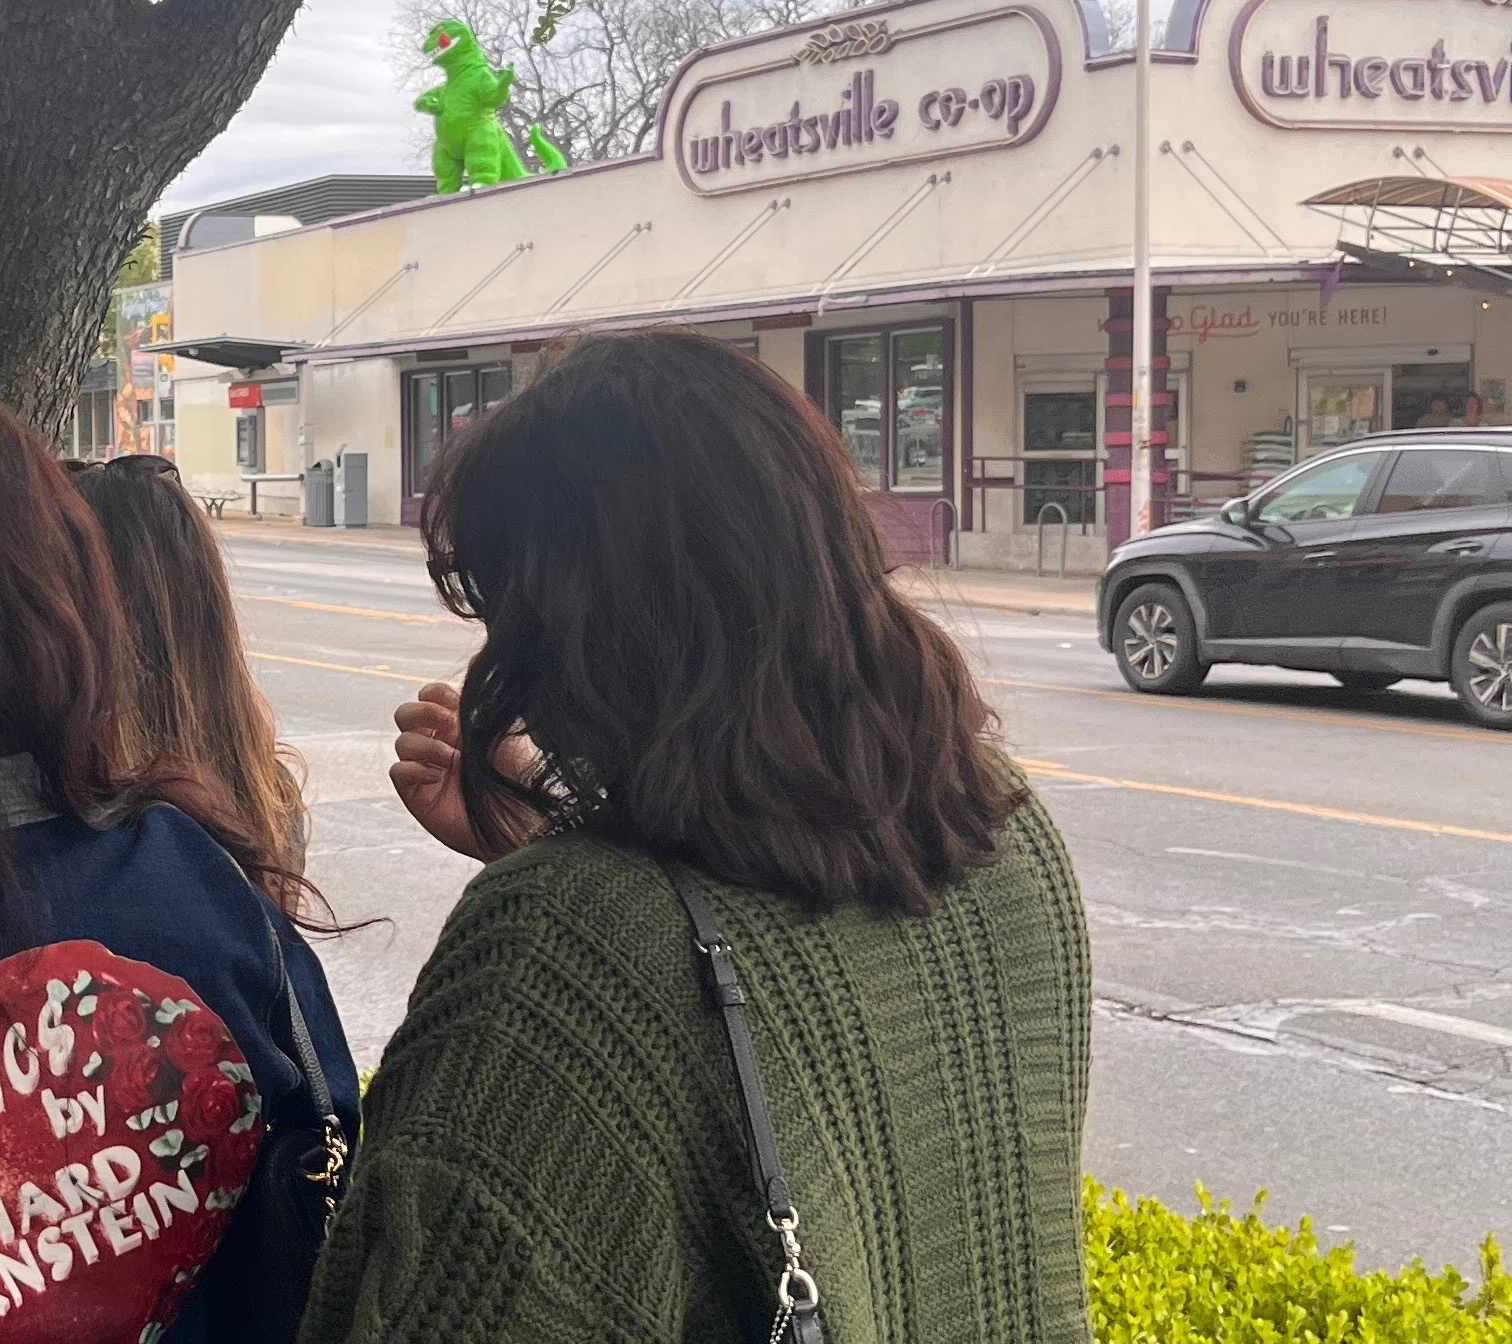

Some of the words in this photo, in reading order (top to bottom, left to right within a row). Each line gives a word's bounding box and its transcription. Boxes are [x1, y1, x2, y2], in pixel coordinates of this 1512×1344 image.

[1260, 15, 1512, 104] wheatsv
[690, 69, 899, 173] wheatsville
[918, 74, 1035, 136] co-op
[1190, 305, 1259, 344] Glad
[1267, 309, 1328, 327] YOU'RE
[1337, 307, 1387, 325] HERE!
[41, 1084, 106, 1139] by
